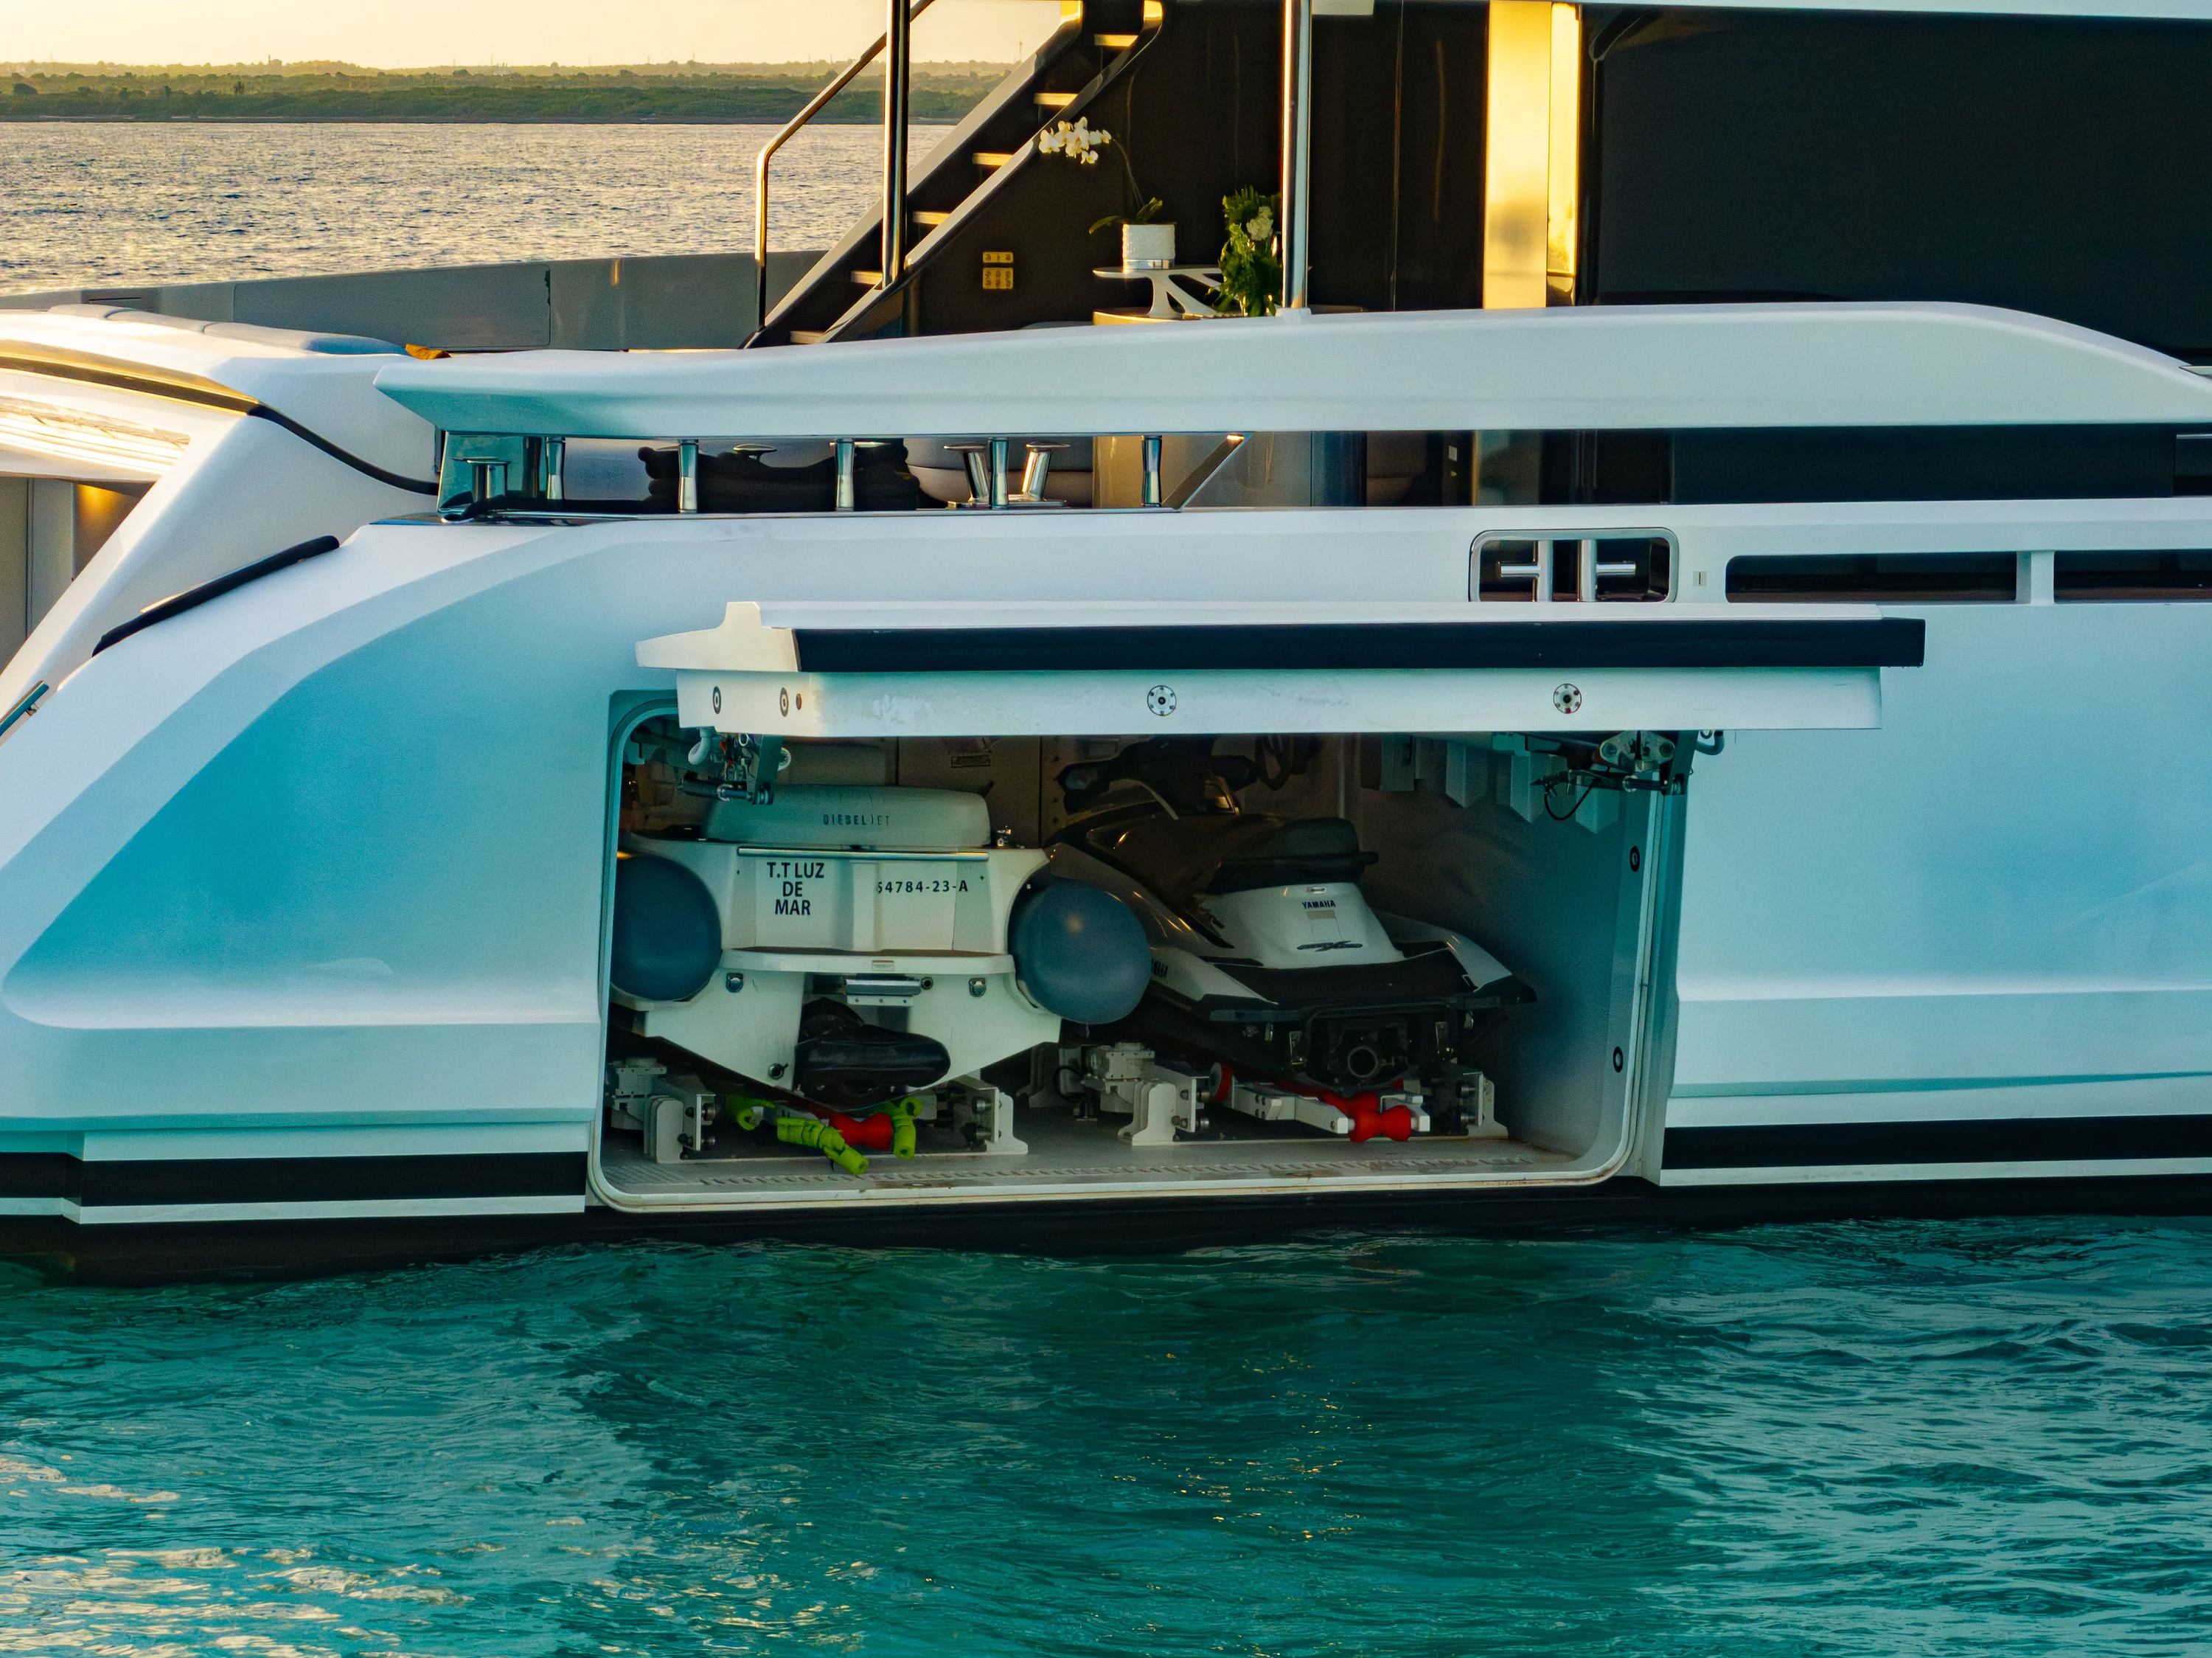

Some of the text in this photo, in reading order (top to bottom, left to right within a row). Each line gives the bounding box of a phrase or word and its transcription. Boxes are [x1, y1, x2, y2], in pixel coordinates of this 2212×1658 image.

[767, 862, 824, 878] T.T LUZ
[782, 881, 803, 897] DE
[775, 899, 811, 915] MAR
[1302, 900, 1336, 909] YAMAHA
